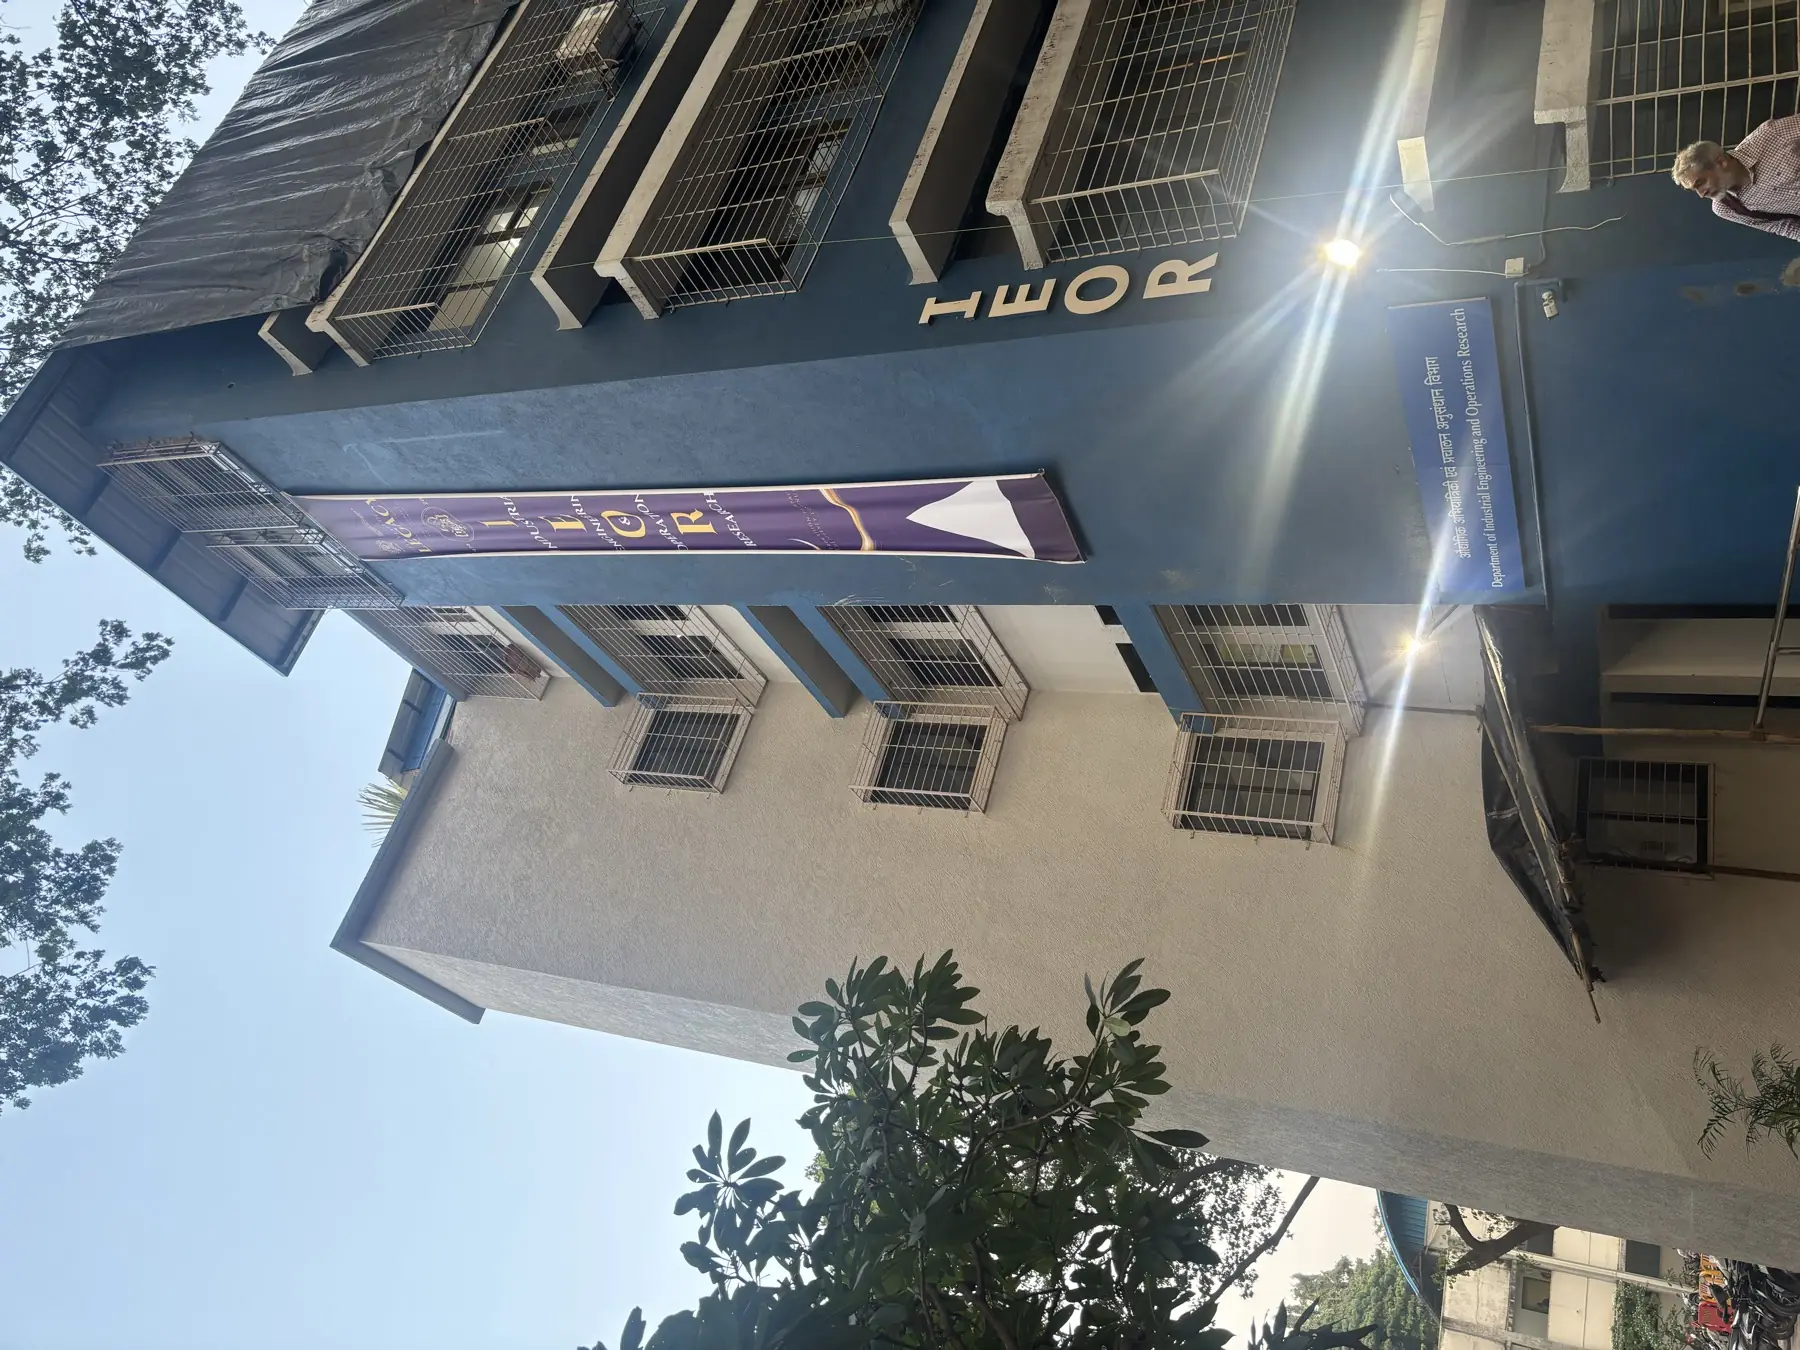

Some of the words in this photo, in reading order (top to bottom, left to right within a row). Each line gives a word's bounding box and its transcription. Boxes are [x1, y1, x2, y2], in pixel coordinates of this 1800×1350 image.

[1450, 308, 1470, 357] Research
[1424, 356, 1442, 386] विभाग
[1460, 360, 1482, 416] Operations
[1430, 388, 1453, 430] अनुसंधान
[1466, 419, 1482, 436] and
[1438, 433, 1455, 463] प्रचालन
[1471, 438, 1492, 490] Engineering
[1440, 466, 1457, 478] एवं
[1442, 480, 1465, 524] अभियांत्रिकी
[1476, 492, 1495, 531] Industrial
[538, 514, 587, 532] E
[601, 510, 646, 538] O
[670, 508, 718, 535] R
[703, 492, 757, 547] RESEARCH
[1453, 526, 1471, 559] औद्योगिक
[1483, 533, 1497, 541] of
[1486, 543, 1506, 587] Department
